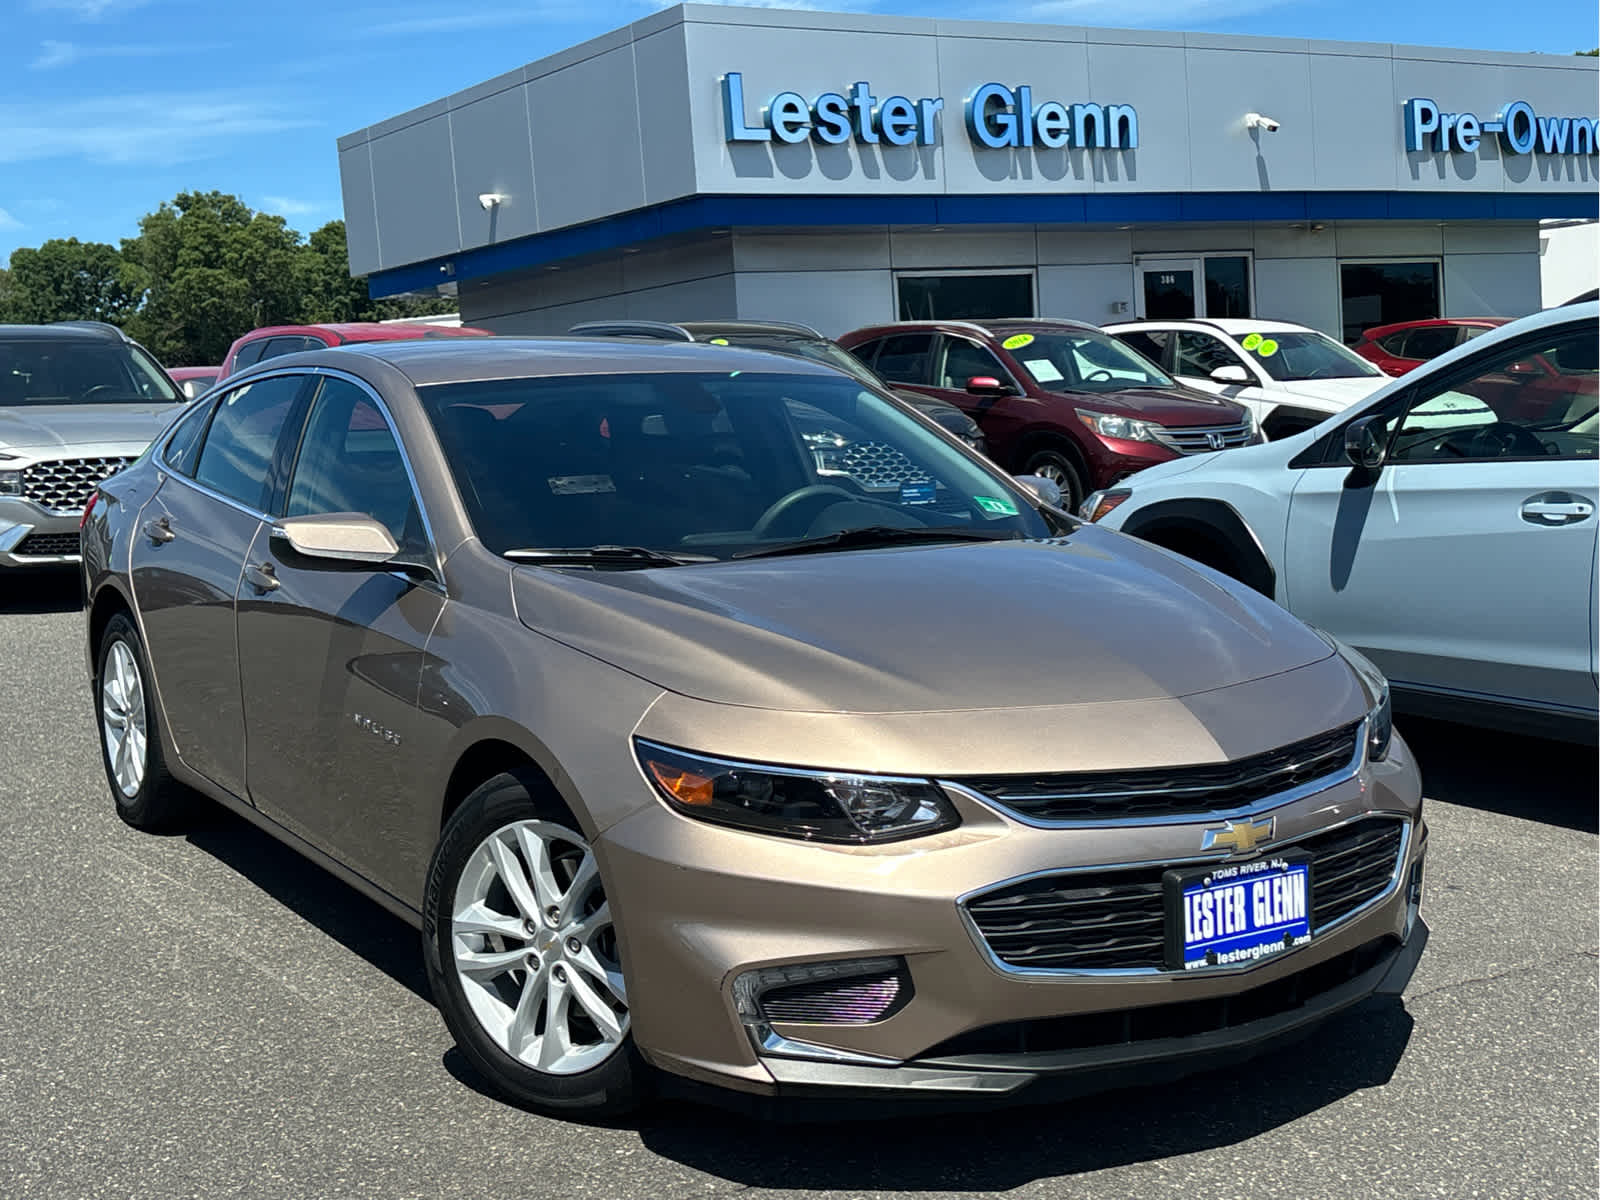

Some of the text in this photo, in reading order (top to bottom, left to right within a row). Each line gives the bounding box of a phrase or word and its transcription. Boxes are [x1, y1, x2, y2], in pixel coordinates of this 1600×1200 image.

[721, 72, 1138, 148] Lester Glenn
[1404, 98, 1599, 156] Pre-Own
[1211, 867, 1239, 880] TOMS
[1183, 873, 1306, 943] LESTER GLENN
